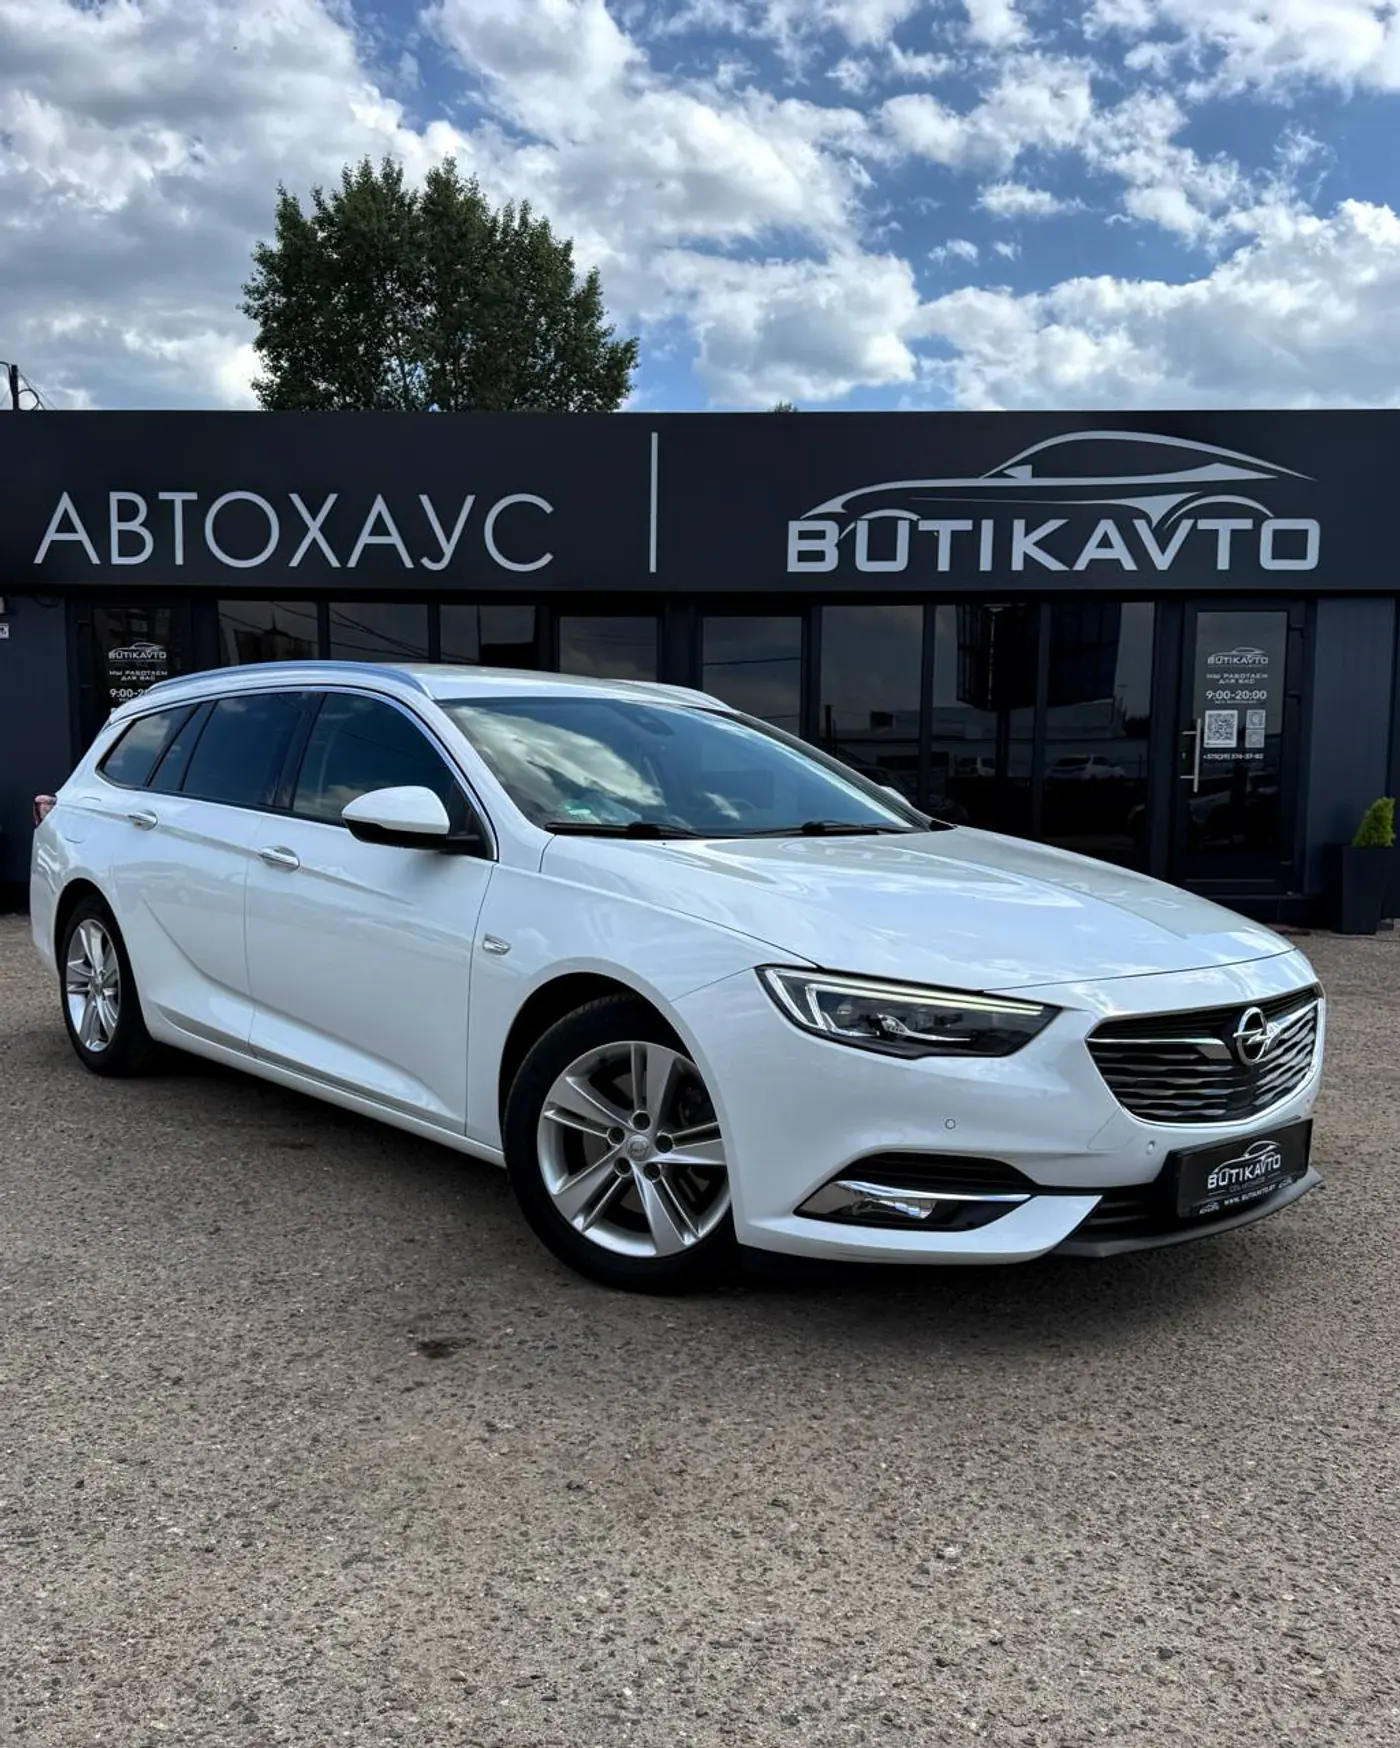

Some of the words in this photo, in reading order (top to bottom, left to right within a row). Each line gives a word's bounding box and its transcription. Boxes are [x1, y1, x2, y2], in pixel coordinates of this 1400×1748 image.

[33, 490, 555, 572] АВТОХАУС
[786, 517, 1321, 573] BUTIKAVTO
[108, 650, 167, 659] BUTIKAVTO
[1207, 655, 1269, 664] BUTIKAVTO
[109, 688, 147, 698] 9:00-2
[1206, 690, 1267, 700] 9:00-20:00
[1207, 1154, 1282, 1189] BUTIKAVTO
